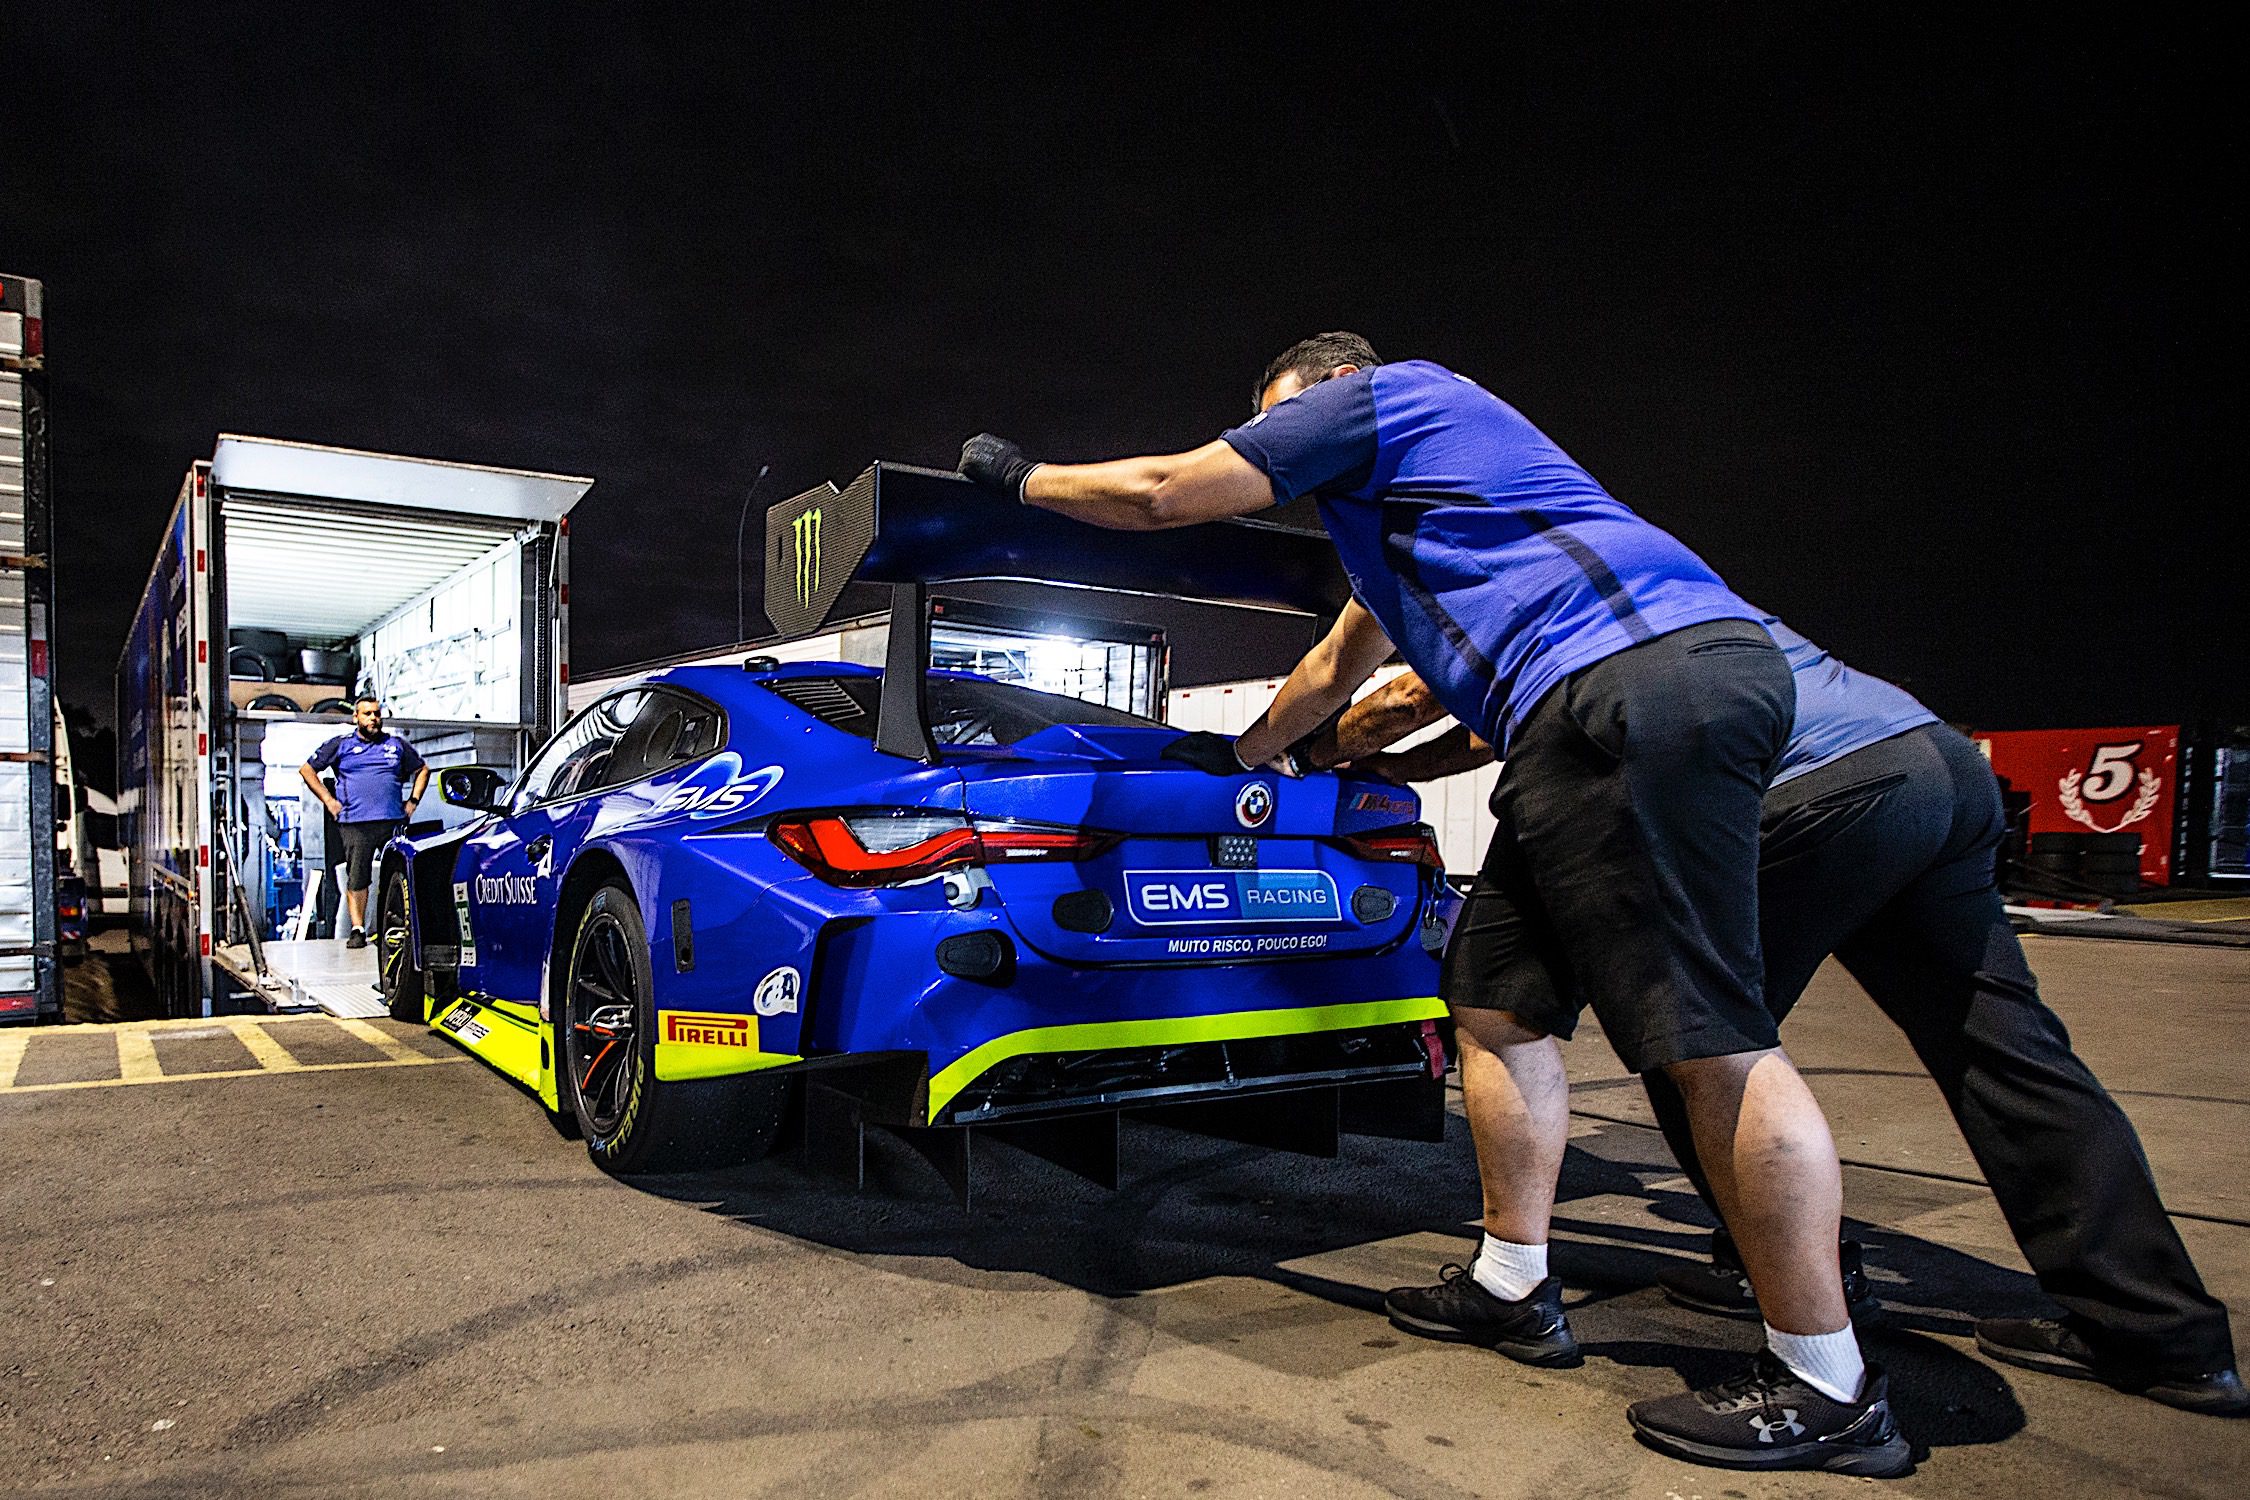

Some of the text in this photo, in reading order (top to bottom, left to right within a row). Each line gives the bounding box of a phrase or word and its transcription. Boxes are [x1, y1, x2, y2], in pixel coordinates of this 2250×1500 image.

[2081, 742, 2143, 802] 5
[654, 784, 759, 814] EMS
[475, 873, 505, 905] CREDIT
[505, 871, 538, 906] SUISSE
[1141, 883, 1327, 910] EMS RACING
[1167, 934, 1328, 954] MUITO RISCO, POUCO EGO!
[667, 1014, 749, 1048] PIRELLI
